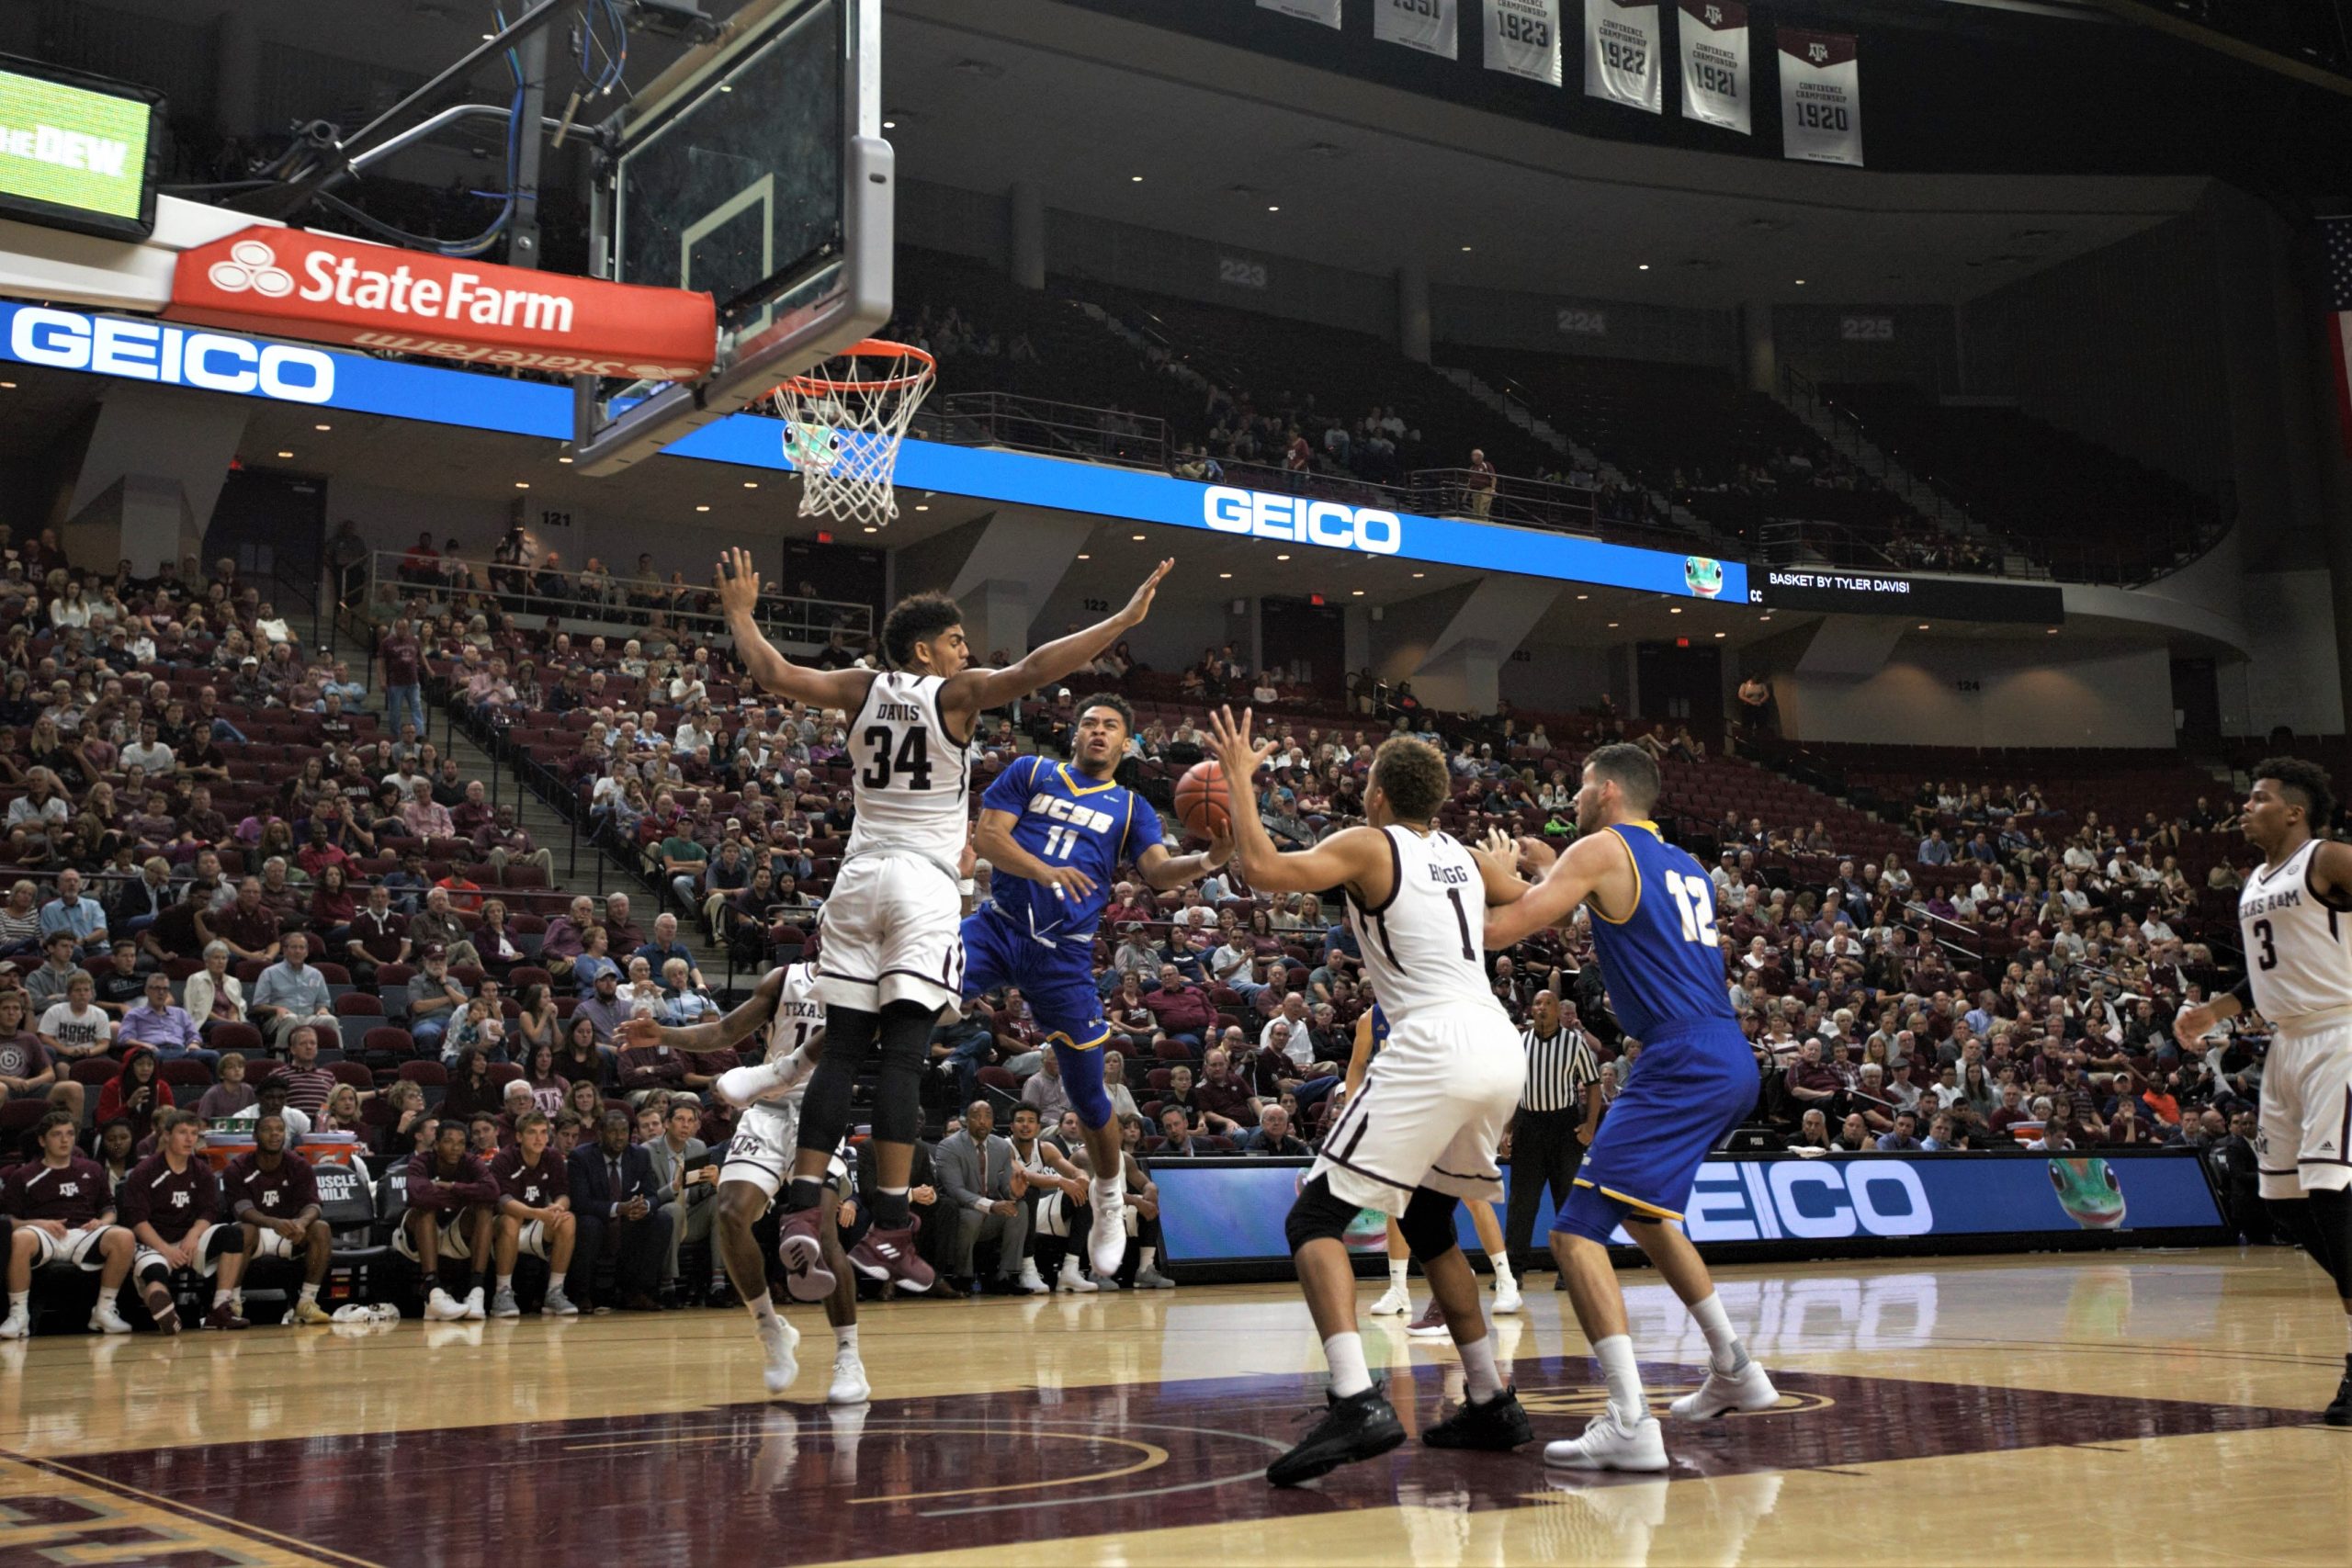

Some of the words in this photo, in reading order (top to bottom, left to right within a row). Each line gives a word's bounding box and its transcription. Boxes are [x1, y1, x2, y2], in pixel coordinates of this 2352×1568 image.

[1498, 10, 1549, 48] 1923
[1599, 27, 1647, 47] CHAMPIONSHIP
[1602, 18, 1643, 38] CONFERENCE
[1600, 39, 1645, 75] 1922
[1692, 51, 1737, 69] CHAMPIONSHIP
[1696, 42, 1735, 59] CONFERENCE
[1695, 62, 1736, 97] 1921
[1799, 82, 1843, 94] CONFERENCE
[1795, 90, 1847, 104] CHAMPIONSHIP
[1796, 102, 1849, 131] 1920
[1220, 260, 1265, 288] 223
[1558, 310, 1602, 333] 224
[1843, 320, 1894, 338] 225
[11, 307, 334, 403] GEICO
[542, 511, 571, 527] 121
[1204, 485, 1401, 555] GEICO
[1770, 572, 1815, 587] BASKET
[1816, 576, 1832, 588] BY
[1835, 577, 1871, 591] TYLER
[1873, 580, 1910, 593] DAVIS!
[1084, 599, 1109, 612] 122
[1750, 589, 1762, 603] CC
[1957, 681, 1980, 691] 124
[876, 704, 920, 721] DAVIS
[863, 726, 932, 790] 34
[1028, 793, 1114, 834] UCSB
[1043, 825, 1080, 860] 11
[1428, 863, 1468, 884] HOGG
[1665, 869, 1718, 947] 12
[2267, 892, 2301, 911] A&M
[1447, 887, 1476, 962] 1
[2254, 919, 2278, 972] 3
[317, 1188, 353, 1201] MILK
[1683, 1160, 1933, 1242] EICO
